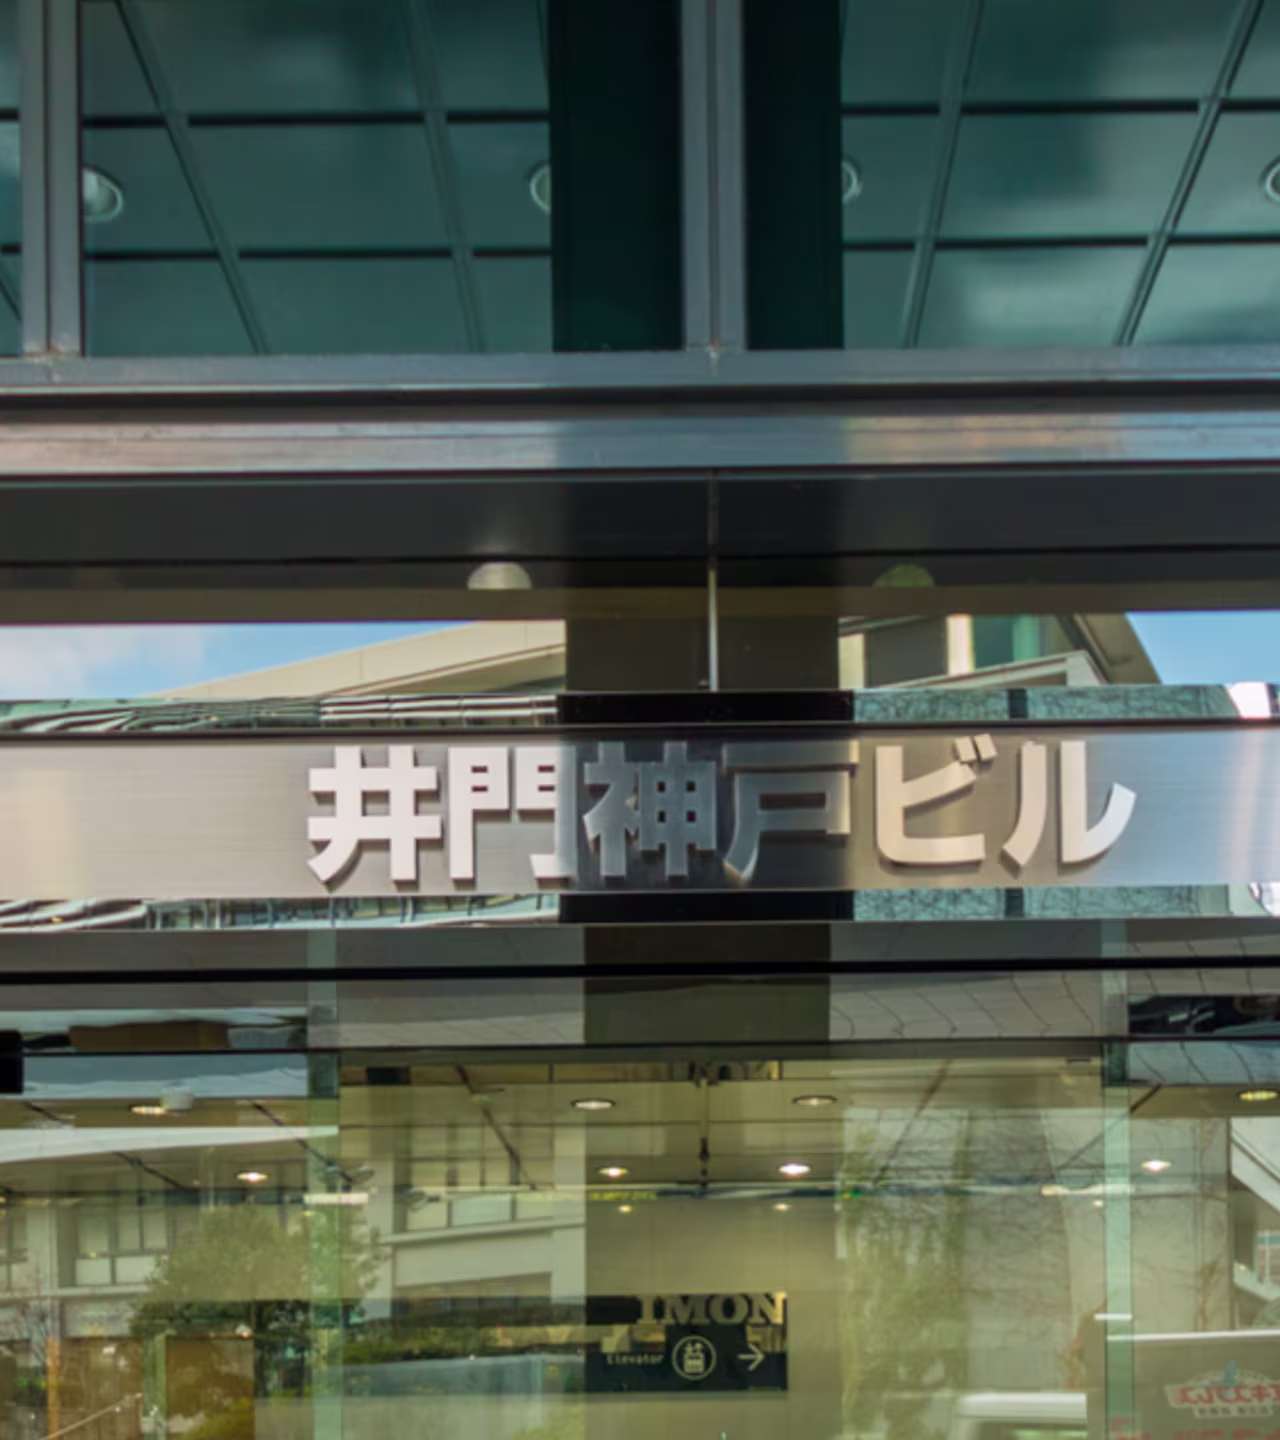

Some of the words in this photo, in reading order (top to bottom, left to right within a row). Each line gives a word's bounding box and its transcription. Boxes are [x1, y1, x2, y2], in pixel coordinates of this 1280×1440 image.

[306, 732, 1135, 883] 井門神戸ビル
[637, 1291, 787, 1325] IMON
[606, 1352, 664, 1366] Elevator
